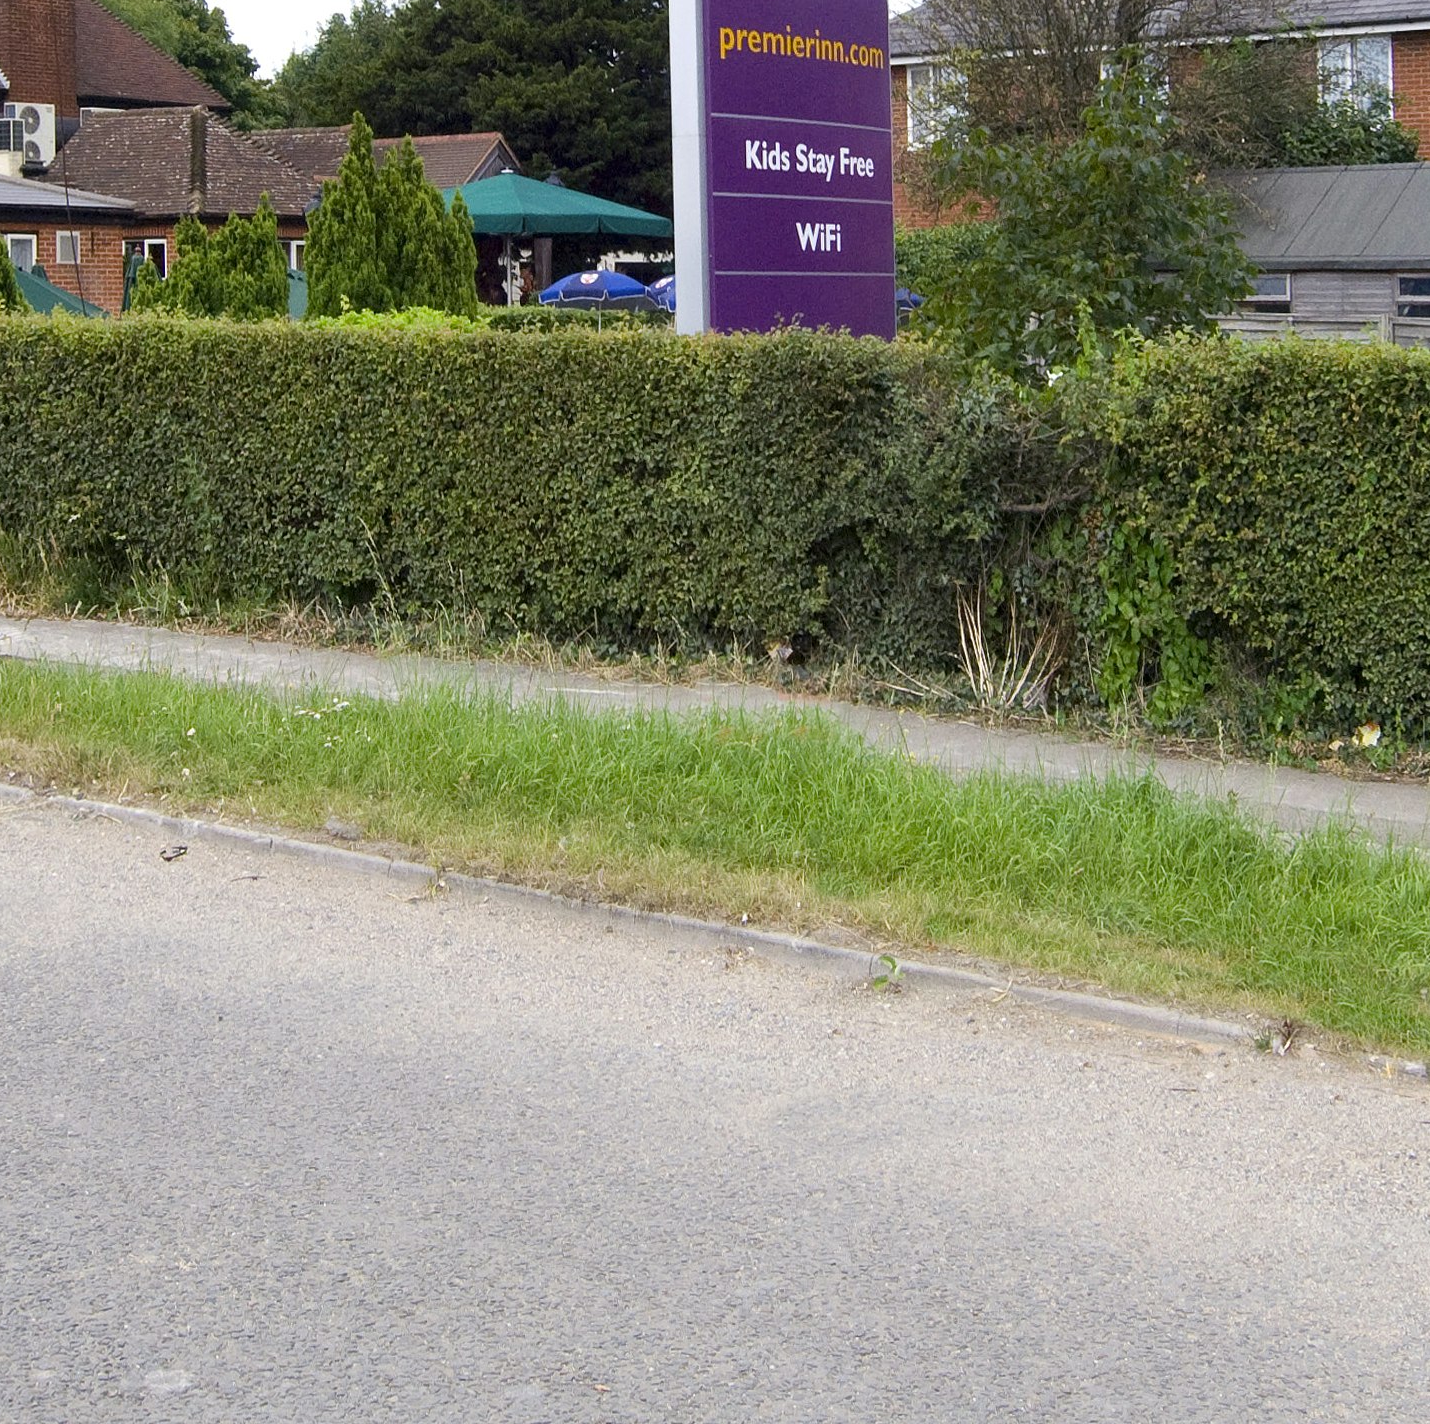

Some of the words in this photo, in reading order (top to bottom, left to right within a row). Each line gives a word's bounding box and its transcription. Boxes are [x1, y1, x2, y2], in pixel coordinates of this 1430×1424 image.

[719, 24, 884, 70] premierinn.com
[745, 139, 790, 172] Kids
[795, 143, 835, 183] Stay
[839, 147, 875, 178] Free
[795, 222, 842, 252] WiFi
